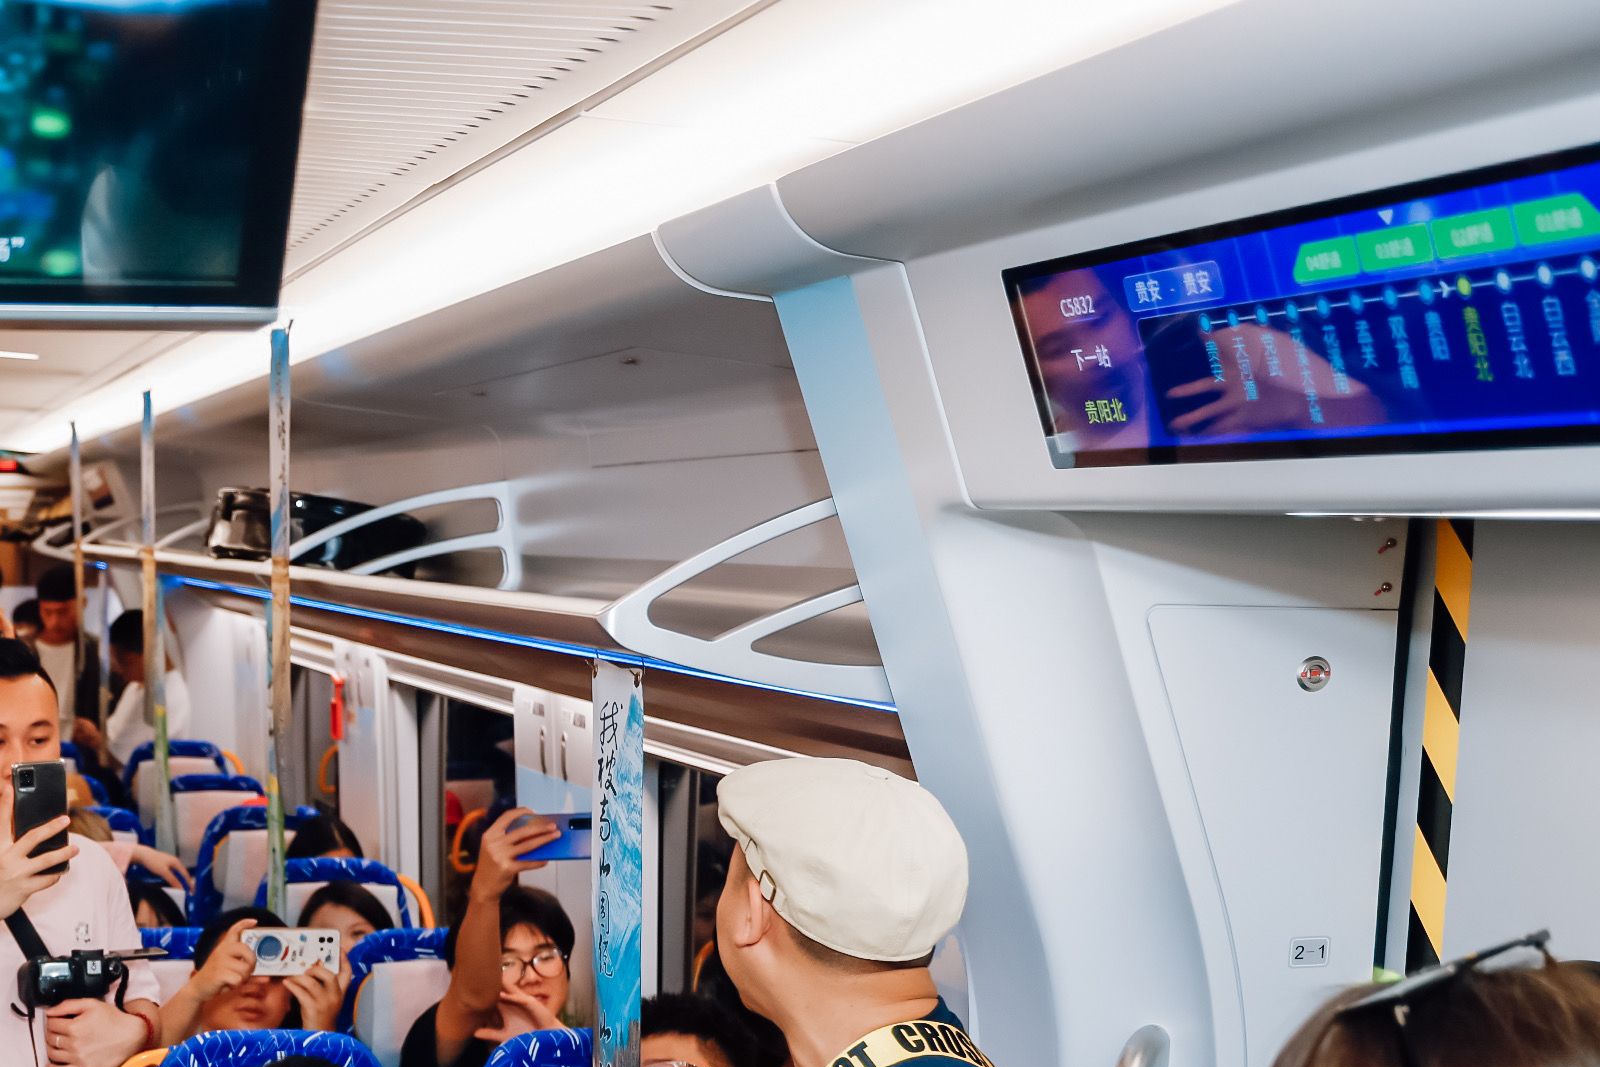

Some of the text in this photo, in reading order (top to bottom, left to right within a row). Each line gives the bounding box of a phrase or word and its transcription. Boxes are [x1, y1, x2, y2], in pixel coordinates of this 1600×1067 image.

[1059, 294, 1096, 318] C5832
[1070, 344, 1112, 372] 下一站
[1084, 397, 1127, 425] 贵阳北
[1294, 944, 1325, 960] 2-1
